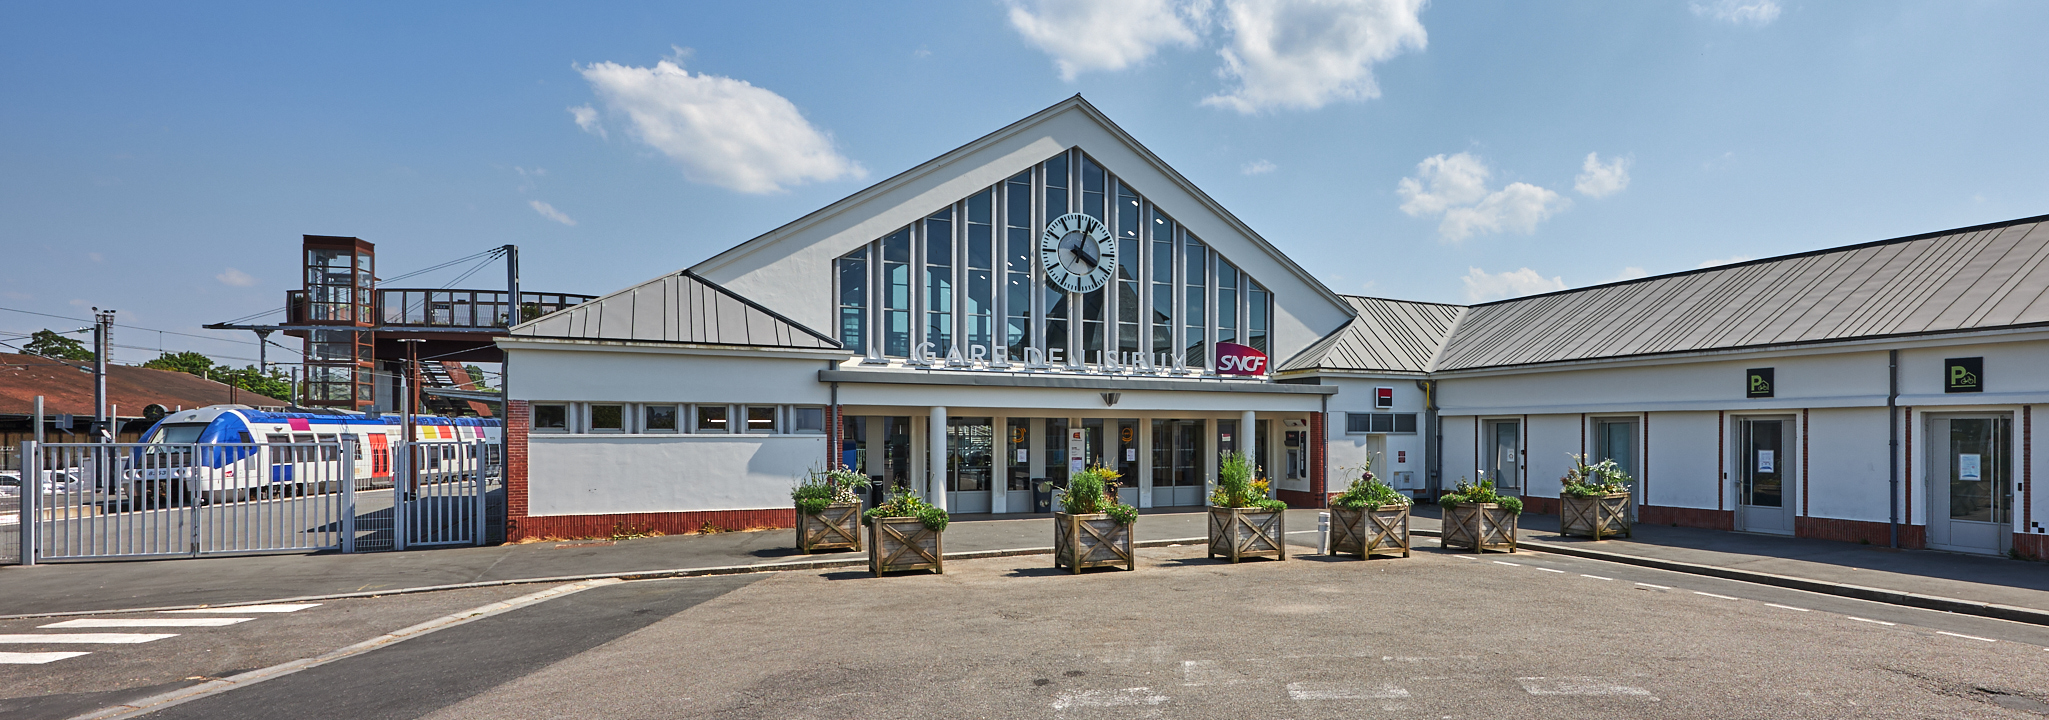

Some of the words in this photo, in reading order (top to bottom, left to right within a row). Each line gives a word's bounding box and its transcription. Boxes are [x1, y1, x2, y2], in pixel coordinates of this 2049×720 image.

[915, 341, 1008, 367] GARE
[1024, 346, 1065, 369] DE
[1081, 349, 1188, 373] LISIEUX
[1218, 354, 1266, 372] SNCF
[1751, 374, 1762, 391] P
[1951, 365, 1966, 385] P
